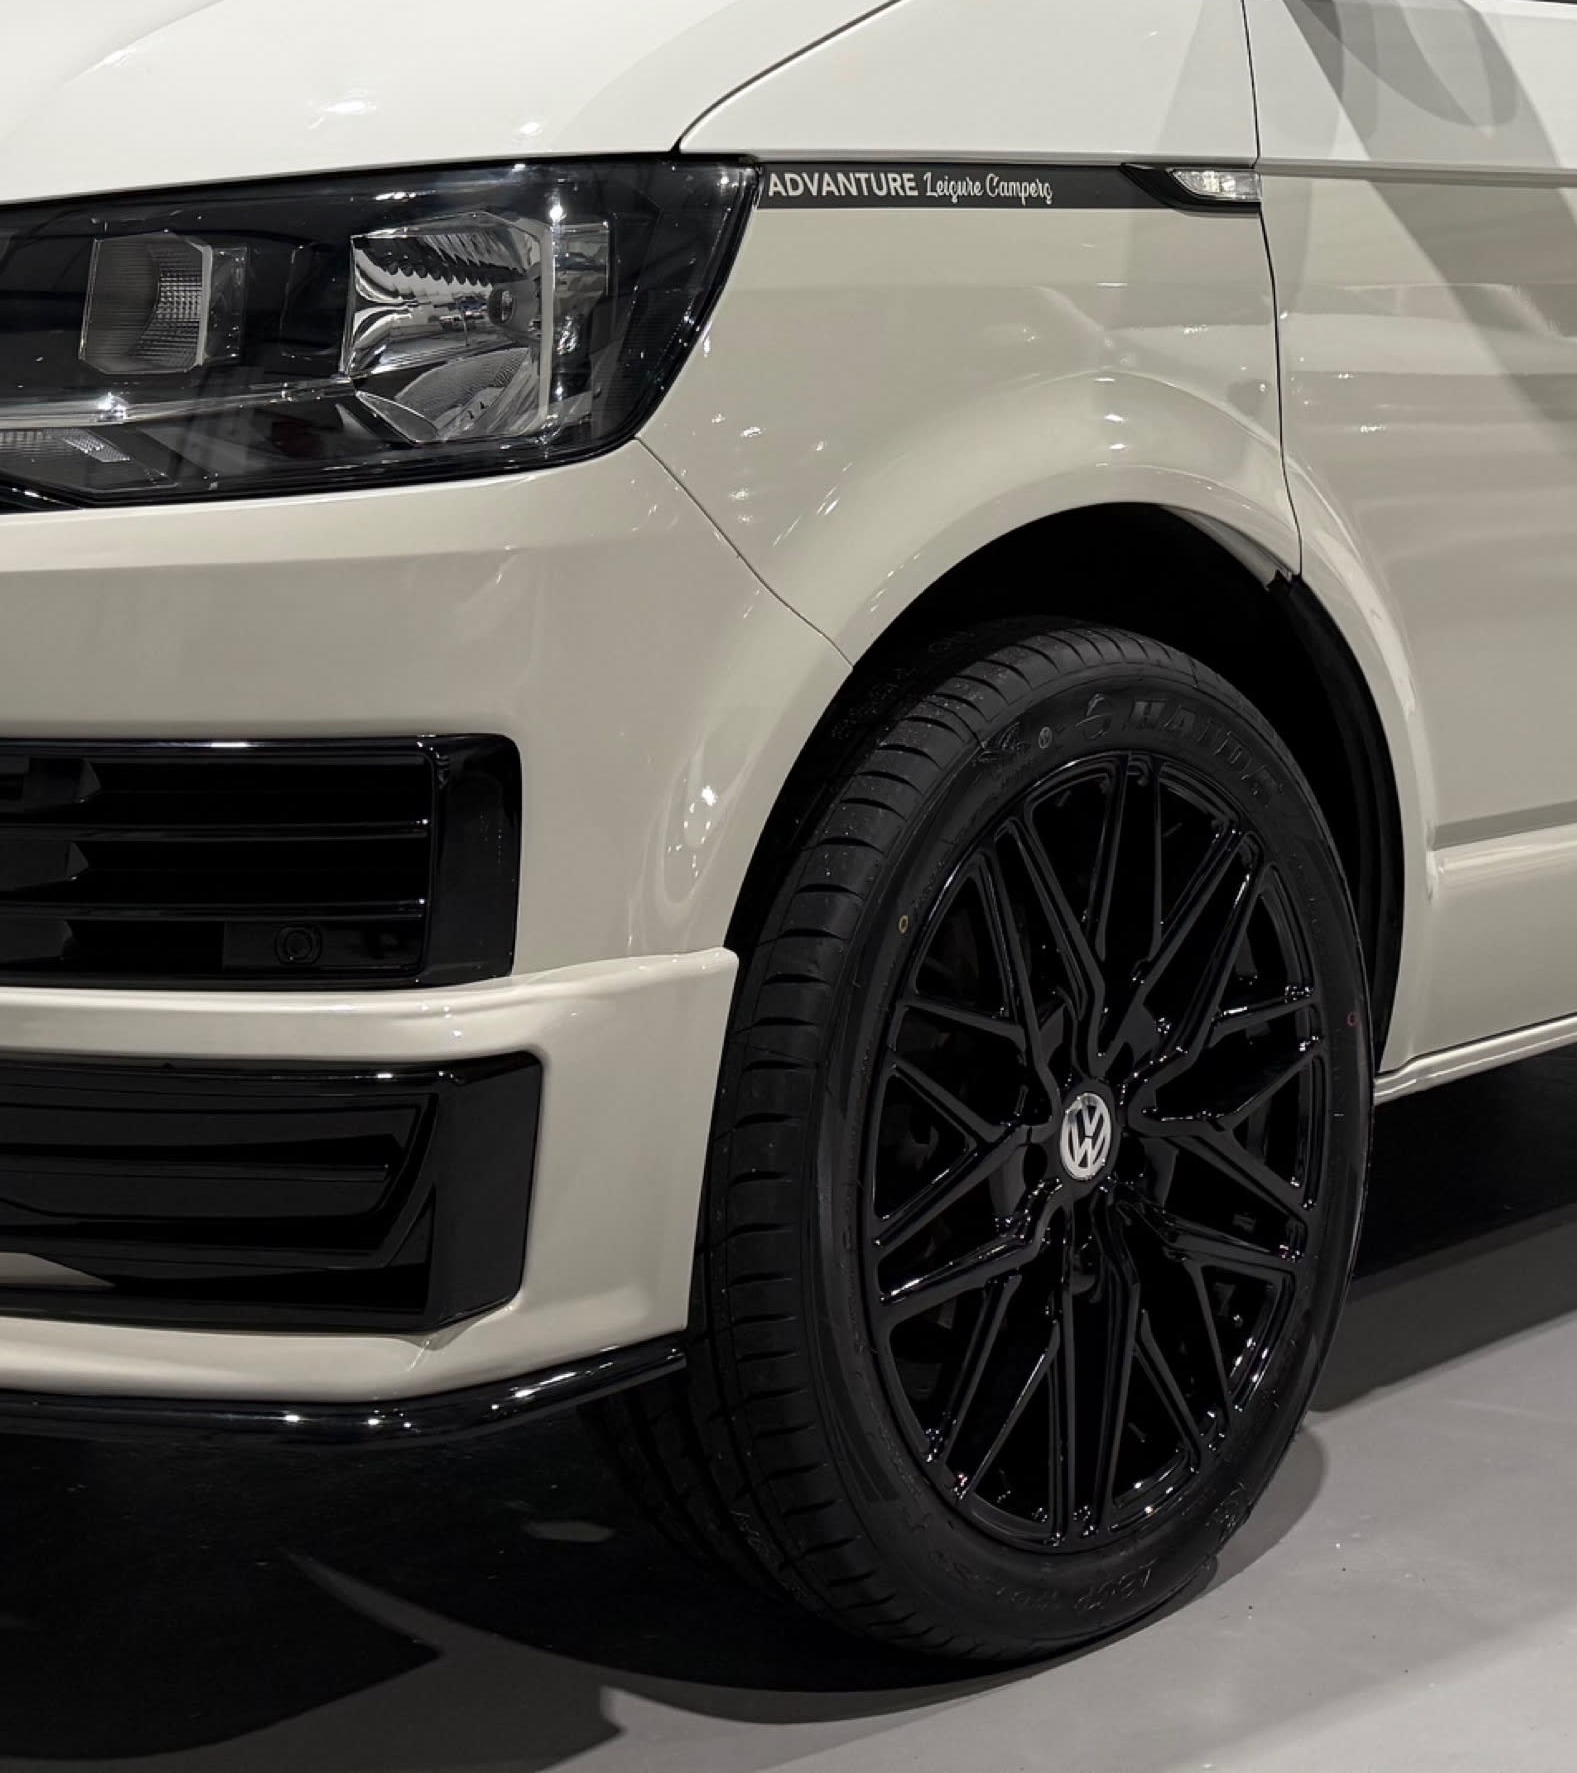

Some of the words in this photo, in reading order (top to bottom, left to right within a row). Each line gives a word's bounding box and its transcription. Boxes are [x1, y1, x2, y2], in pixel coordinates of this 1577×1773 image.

[767, 171, 920, 198] ADVANTURE
[922, 171, 985, 204] Leisure
[985, 173, 1054, 206] Campers
[1059, 1092, 1113, 1180] VW
